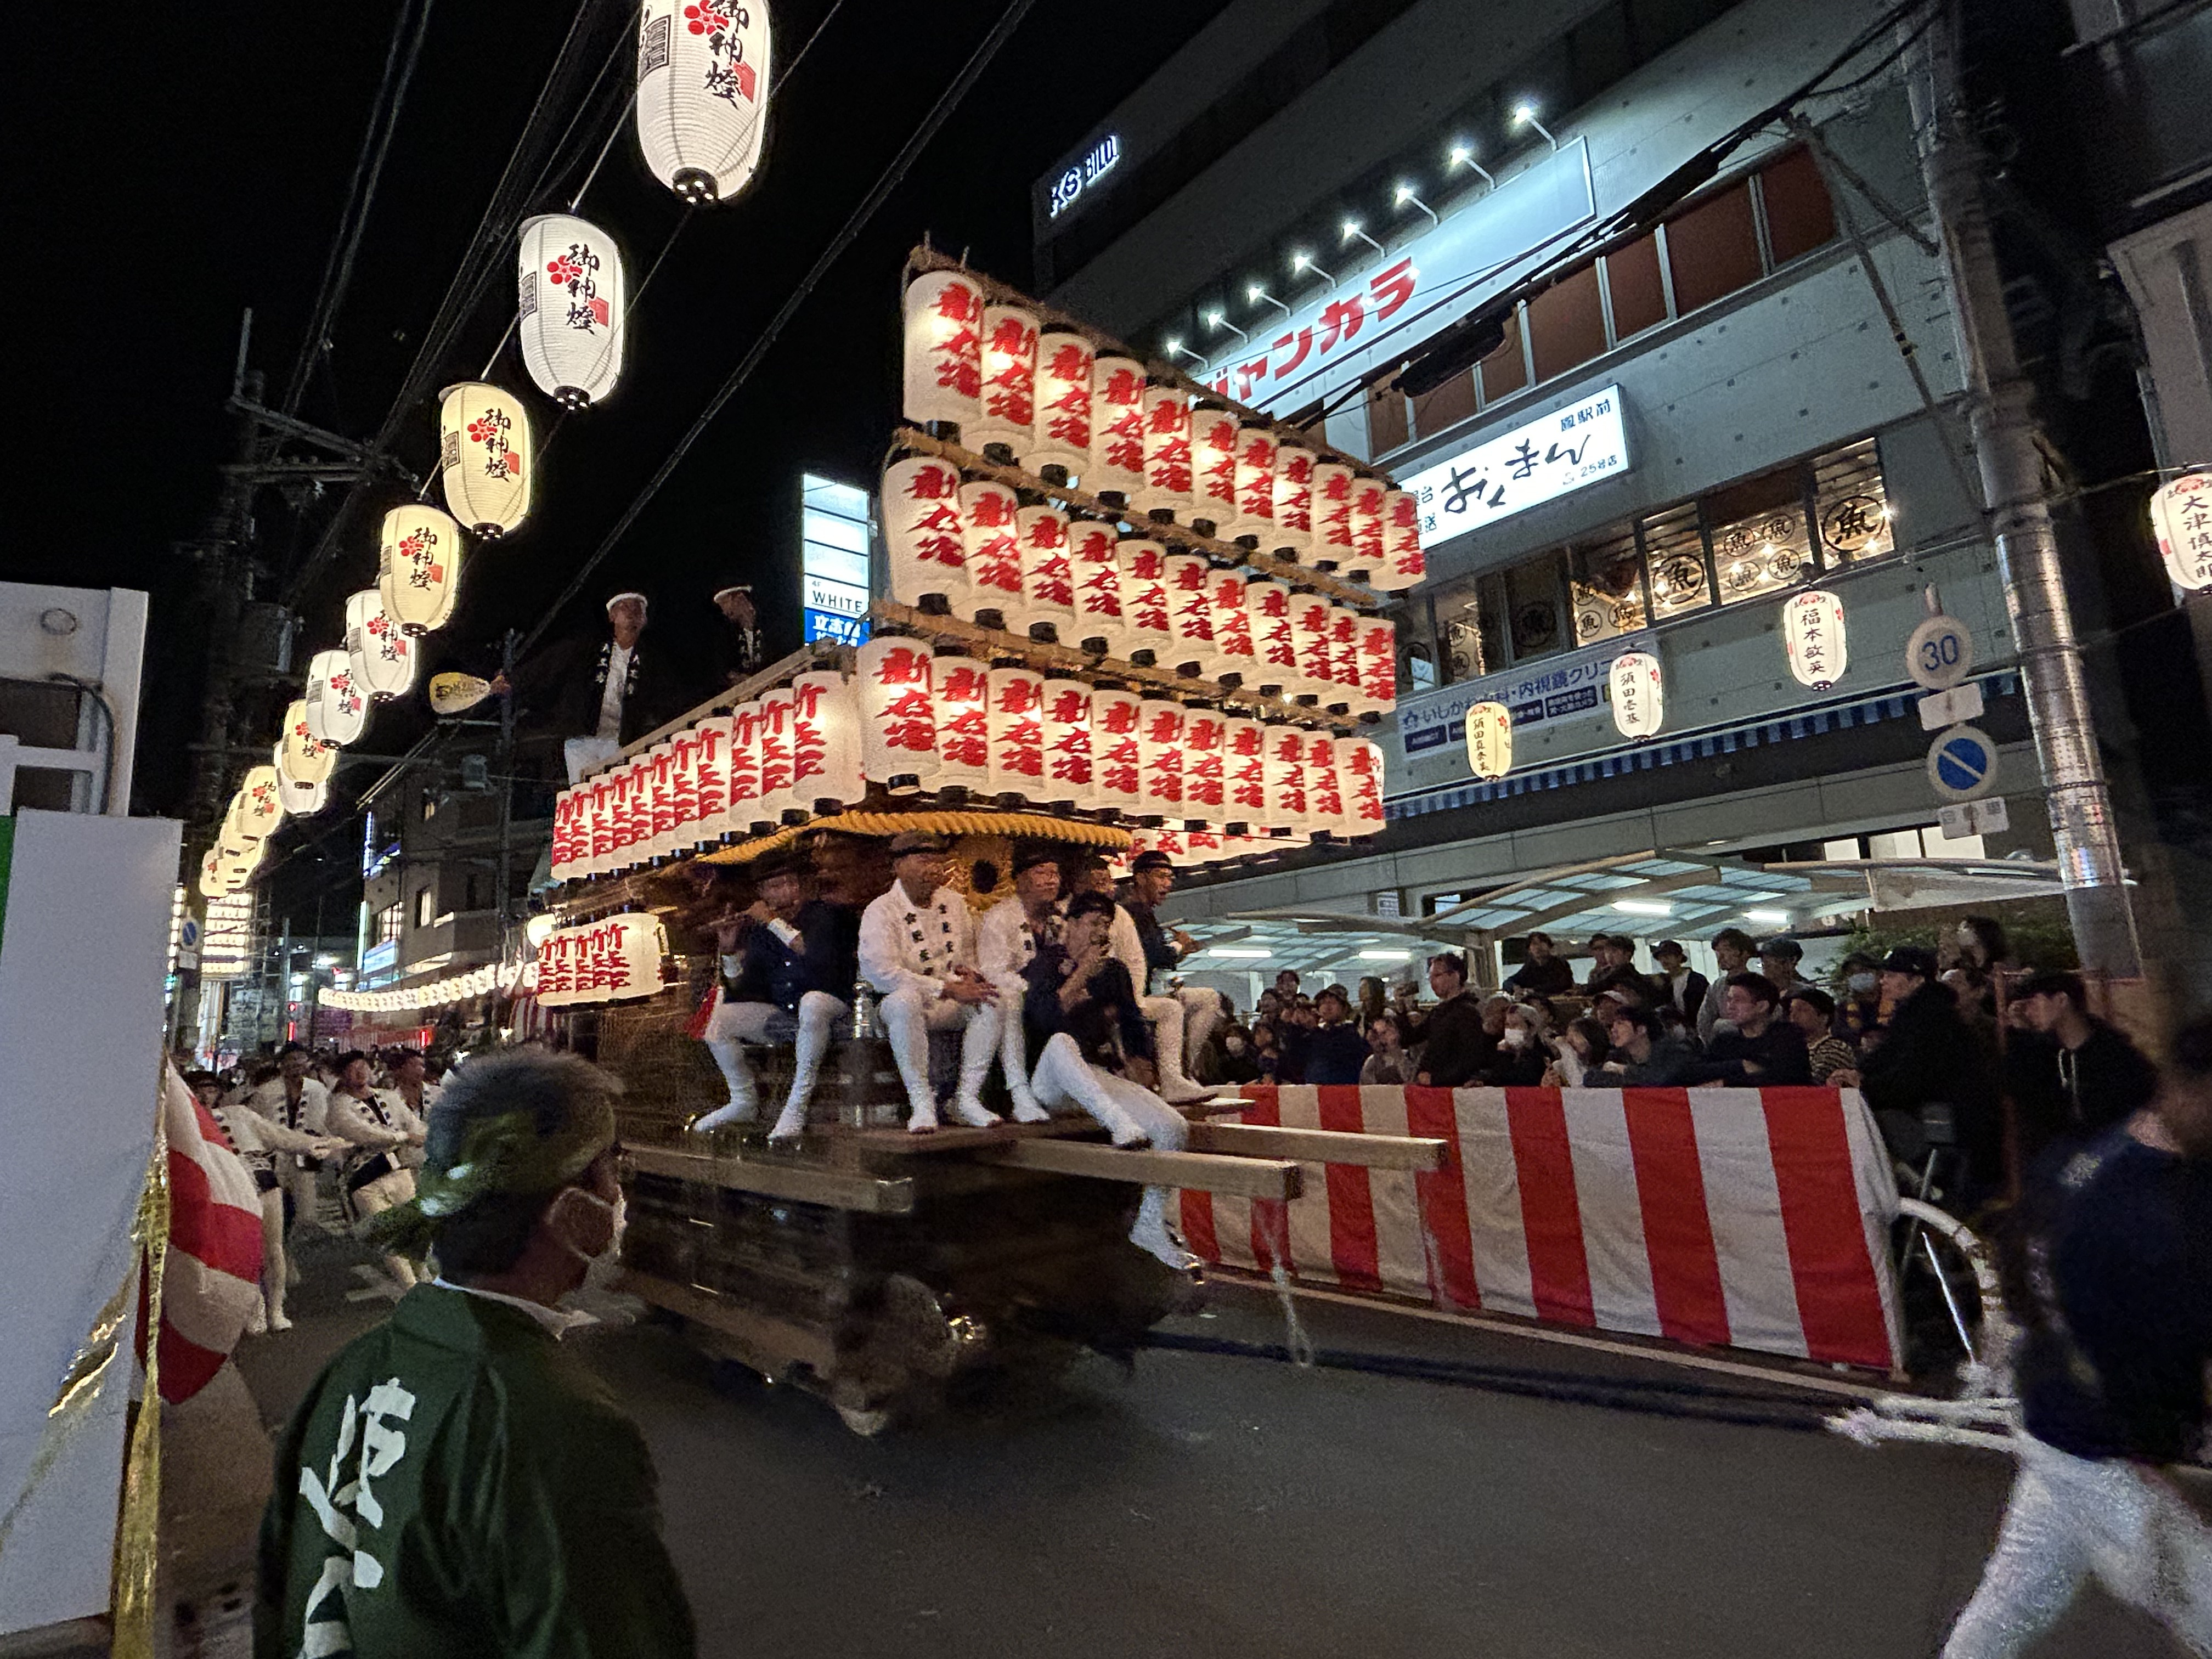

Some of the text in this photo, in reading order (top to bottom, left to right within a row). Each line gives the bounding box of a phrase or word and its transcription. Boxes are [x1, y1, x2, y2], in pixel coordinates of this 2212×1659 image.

[566, 244, 599, 336] 御神燈
[485, 408, 511, 482] 御神燈
[1766, 519, 1790, 540] 魚
[1835, 504, 1878, 545] 魚
[1730, 532, 1751, 551] 魚
[409, 527, 438, 591] 御神燈
[1774, 555, 1795, 575] 魚
[1663, 562, 1697, 591] 魚
[812, 590, 862, 613] WHITE
[1581, 615, 1599, 633] 魚
[1921, 635, 1960, 672] 30
